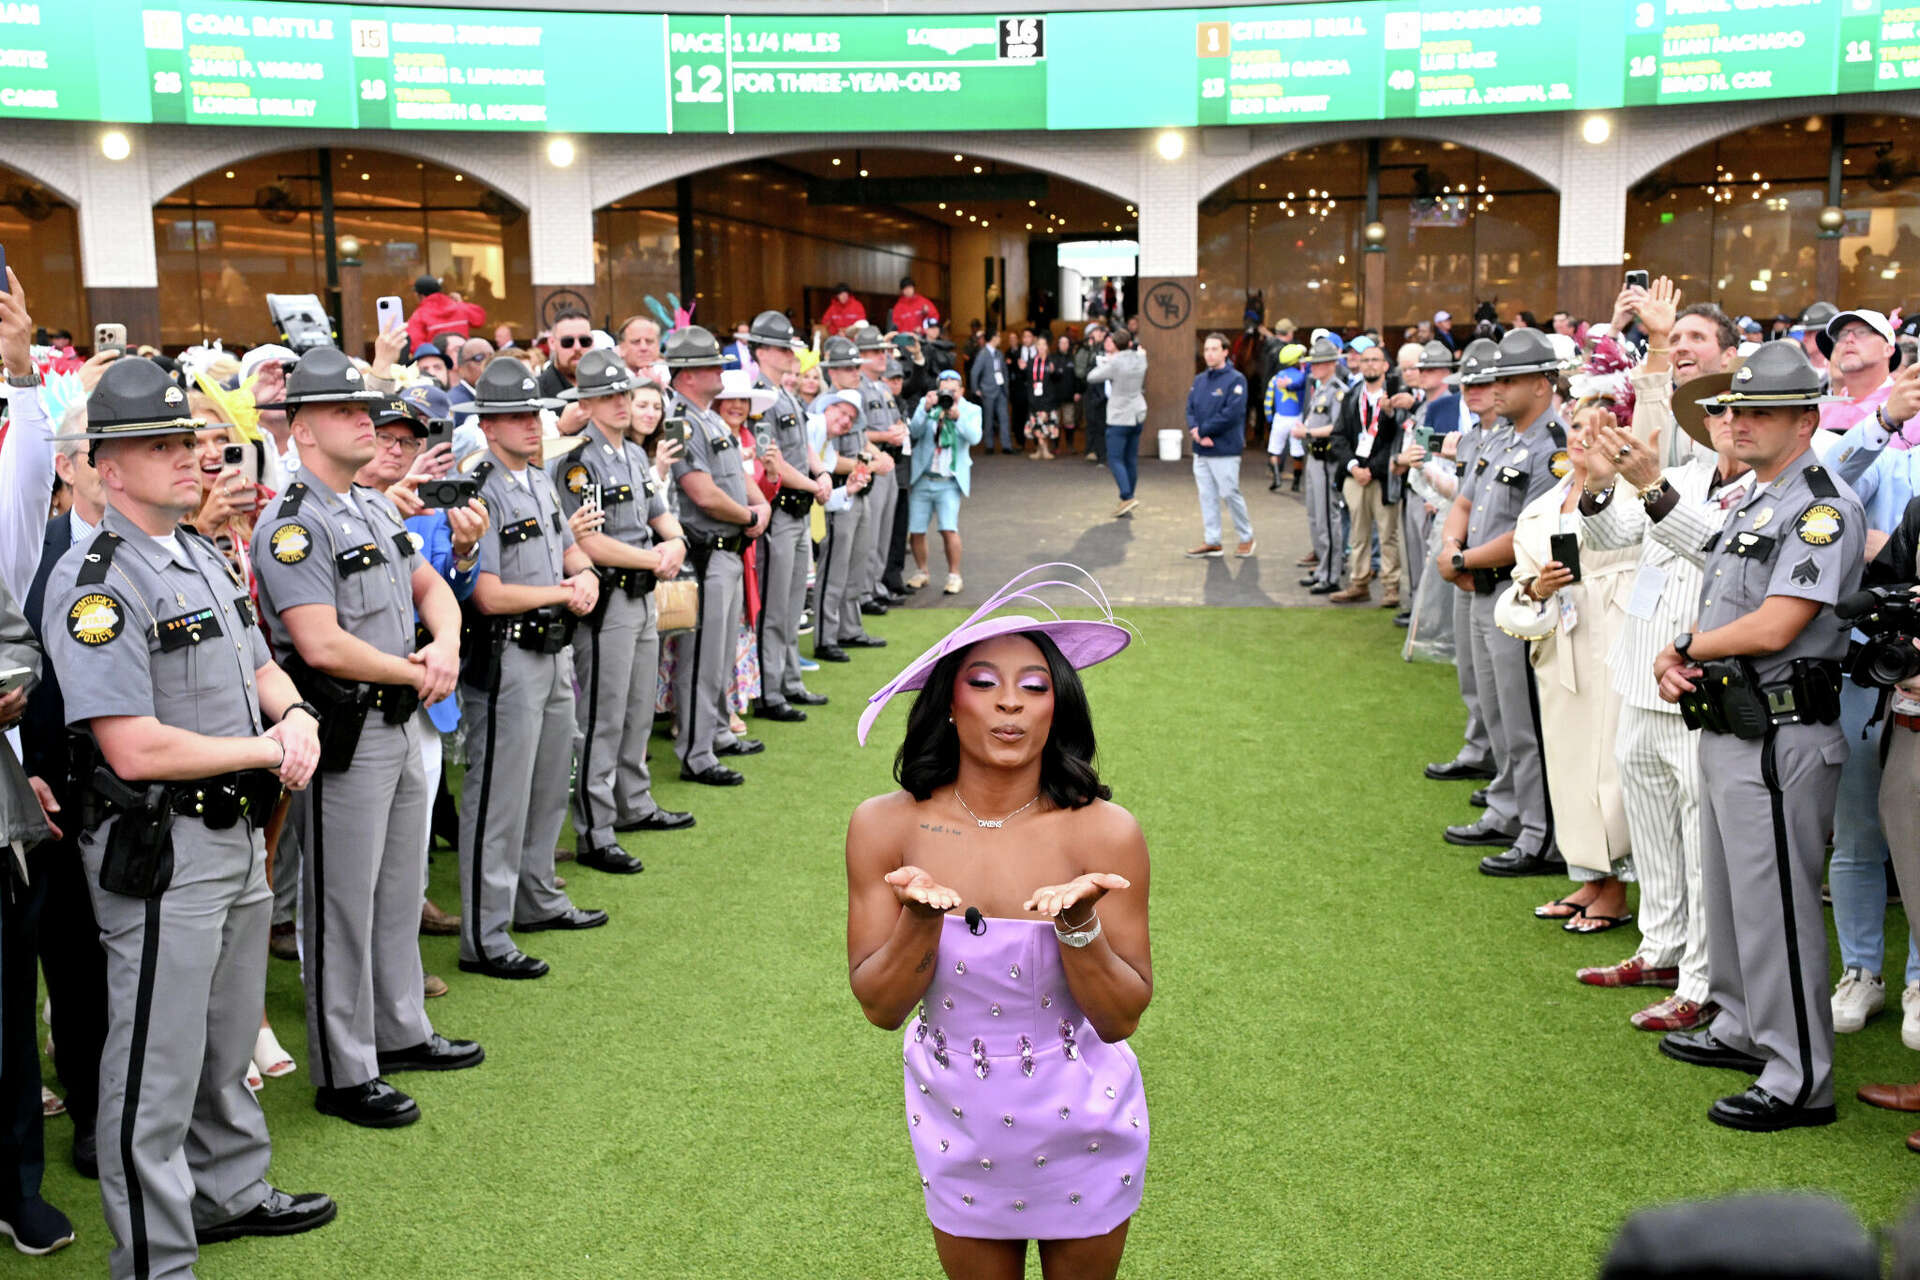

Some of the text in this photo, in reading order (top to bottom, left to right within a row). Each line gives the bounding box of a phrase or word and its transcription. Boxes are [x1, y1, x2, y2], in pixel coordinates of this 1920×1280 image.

[187, 13, 334, 40] COAL BATTLE
[1006, 19, 1038, 44] 16
[671, 32, 725, 53] RACE
[732, 32, 840, 53] 1 1/4 MILES
[1207, 27, 1220, 52] 1
[674, 64, 724, 103] 12
[733, 72, 962, 93] FOR THREE-YEAR-OLDS
[1801, 505, 1841, 521] KENTUCKY
[1800, 531, 1833, 544] POLICE
[71, 594, 117, 618] KENTUCKY
[76, 629, 116, 643] POLICE
